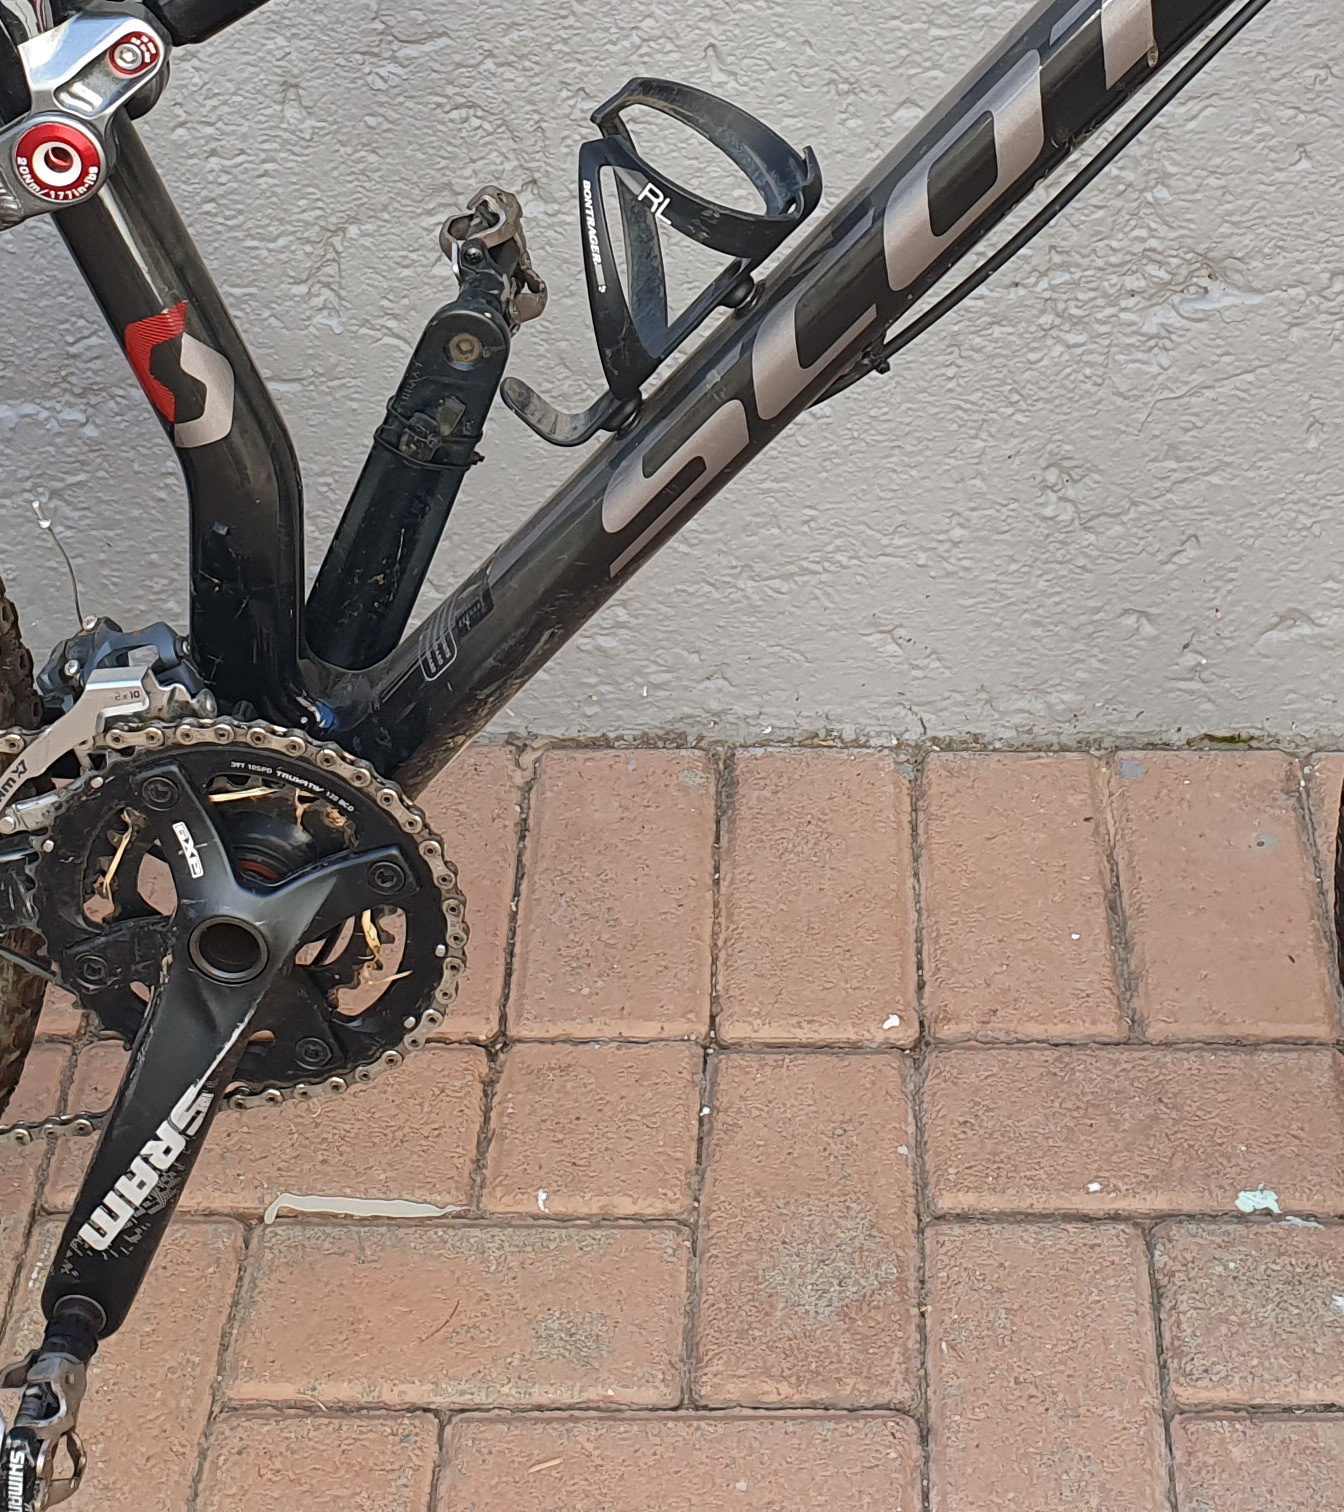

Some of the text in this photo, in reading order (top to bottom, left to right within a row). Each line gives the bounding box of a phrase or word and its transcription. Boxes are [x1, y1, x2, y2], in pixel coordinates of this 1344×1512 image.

[582, 180, 602, 266] BONTRAGER
[638, 182, 672, 225] RL
[10, 758, 29, 779] X7
[173, 822, 204, 879] GXP
[78, 1082, 215, 1251] SRAM
[7, 1450, 25, 1512] SHIMA
